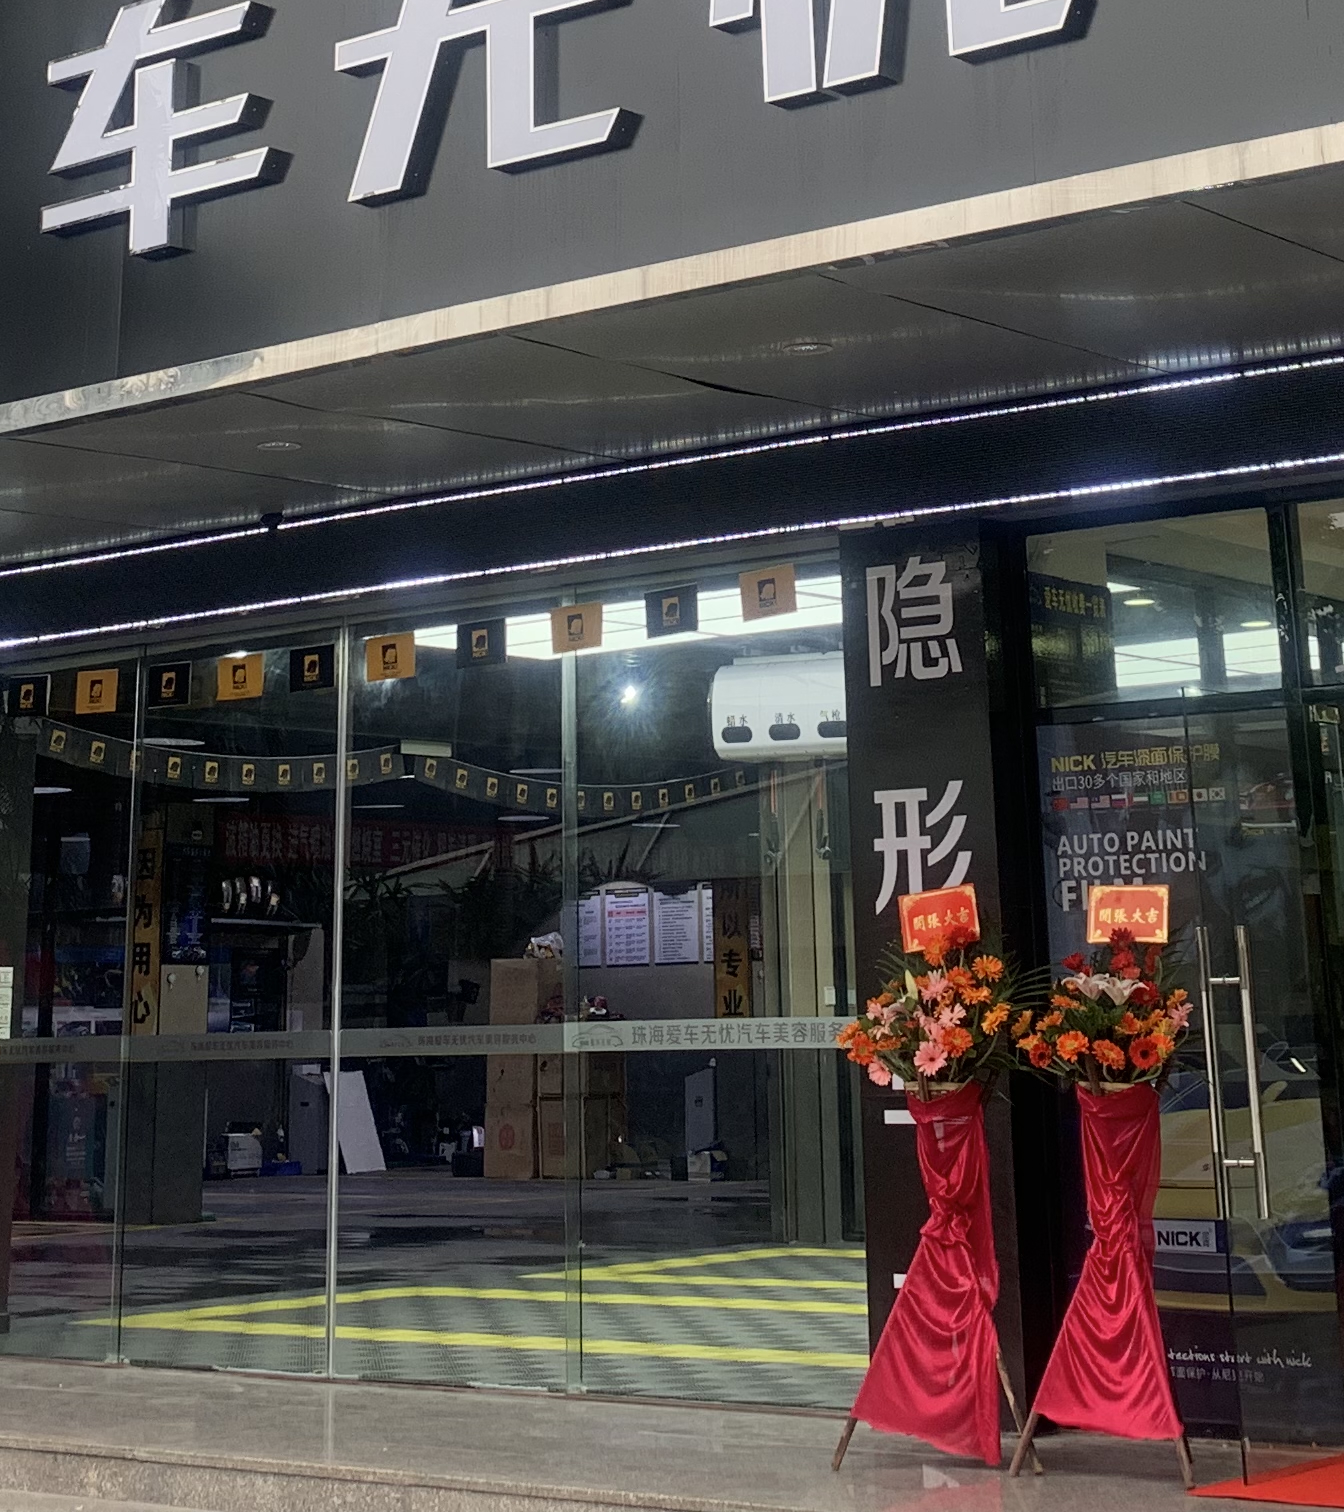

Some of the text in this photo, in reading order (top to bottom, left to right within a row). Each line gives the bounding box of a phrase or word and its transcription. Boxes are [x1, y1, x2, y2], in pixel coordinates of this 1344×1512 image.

[1051, 753, 1097, 774] NICK
[1052, 768, 1187, 791] 出口30多个国家和地区
[1057, 828, 1197, 856] AUTO PAINT
[1058, 851, 1208, 878] PROTECTION
[1157, 1230, 1202, 1249] NICK
